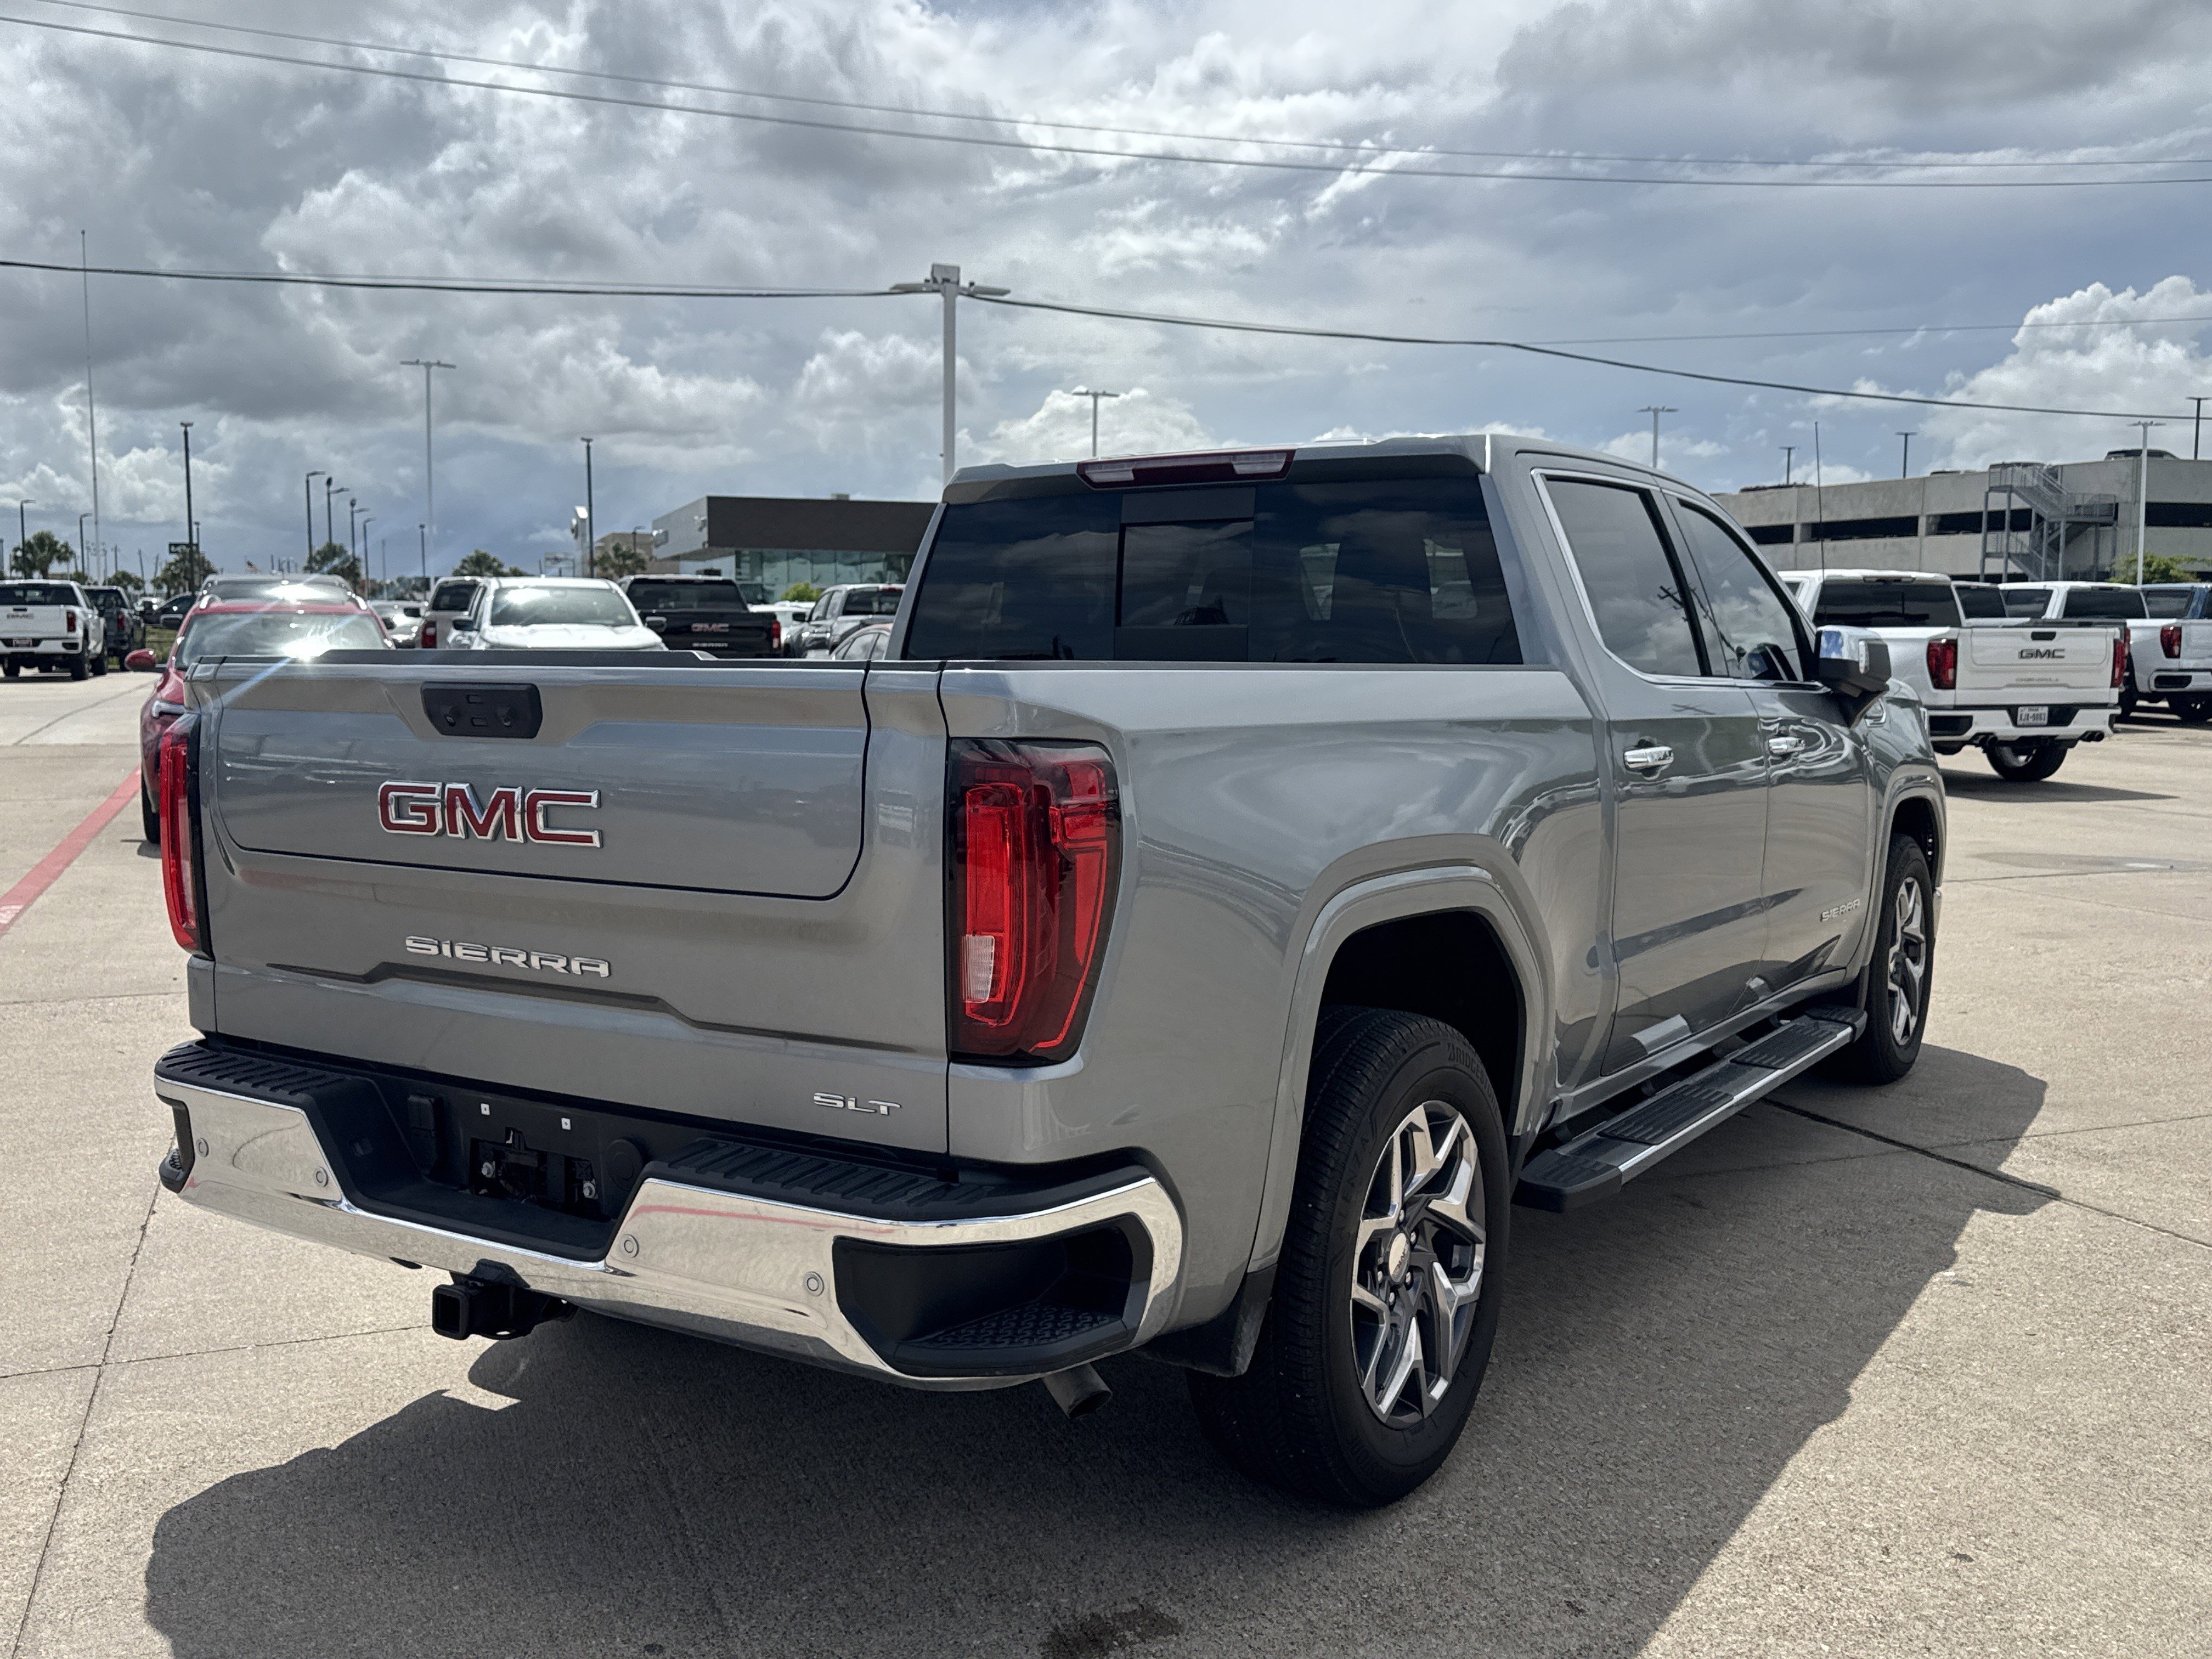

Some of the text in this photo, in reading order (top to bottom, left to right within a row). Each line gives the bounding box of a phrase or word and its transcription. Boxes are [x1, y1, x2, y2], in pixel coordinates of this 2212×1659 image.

[691, 623, 729, 632] GMC
[2018, 648, 2065, 658] GMC
[379, 780, 603, 848] GMC
[1820, 899, 1860, 922] SIERRA
[406, 935, 611, 978] SIERRA
[814, 1092, 901, 1116] SLT
